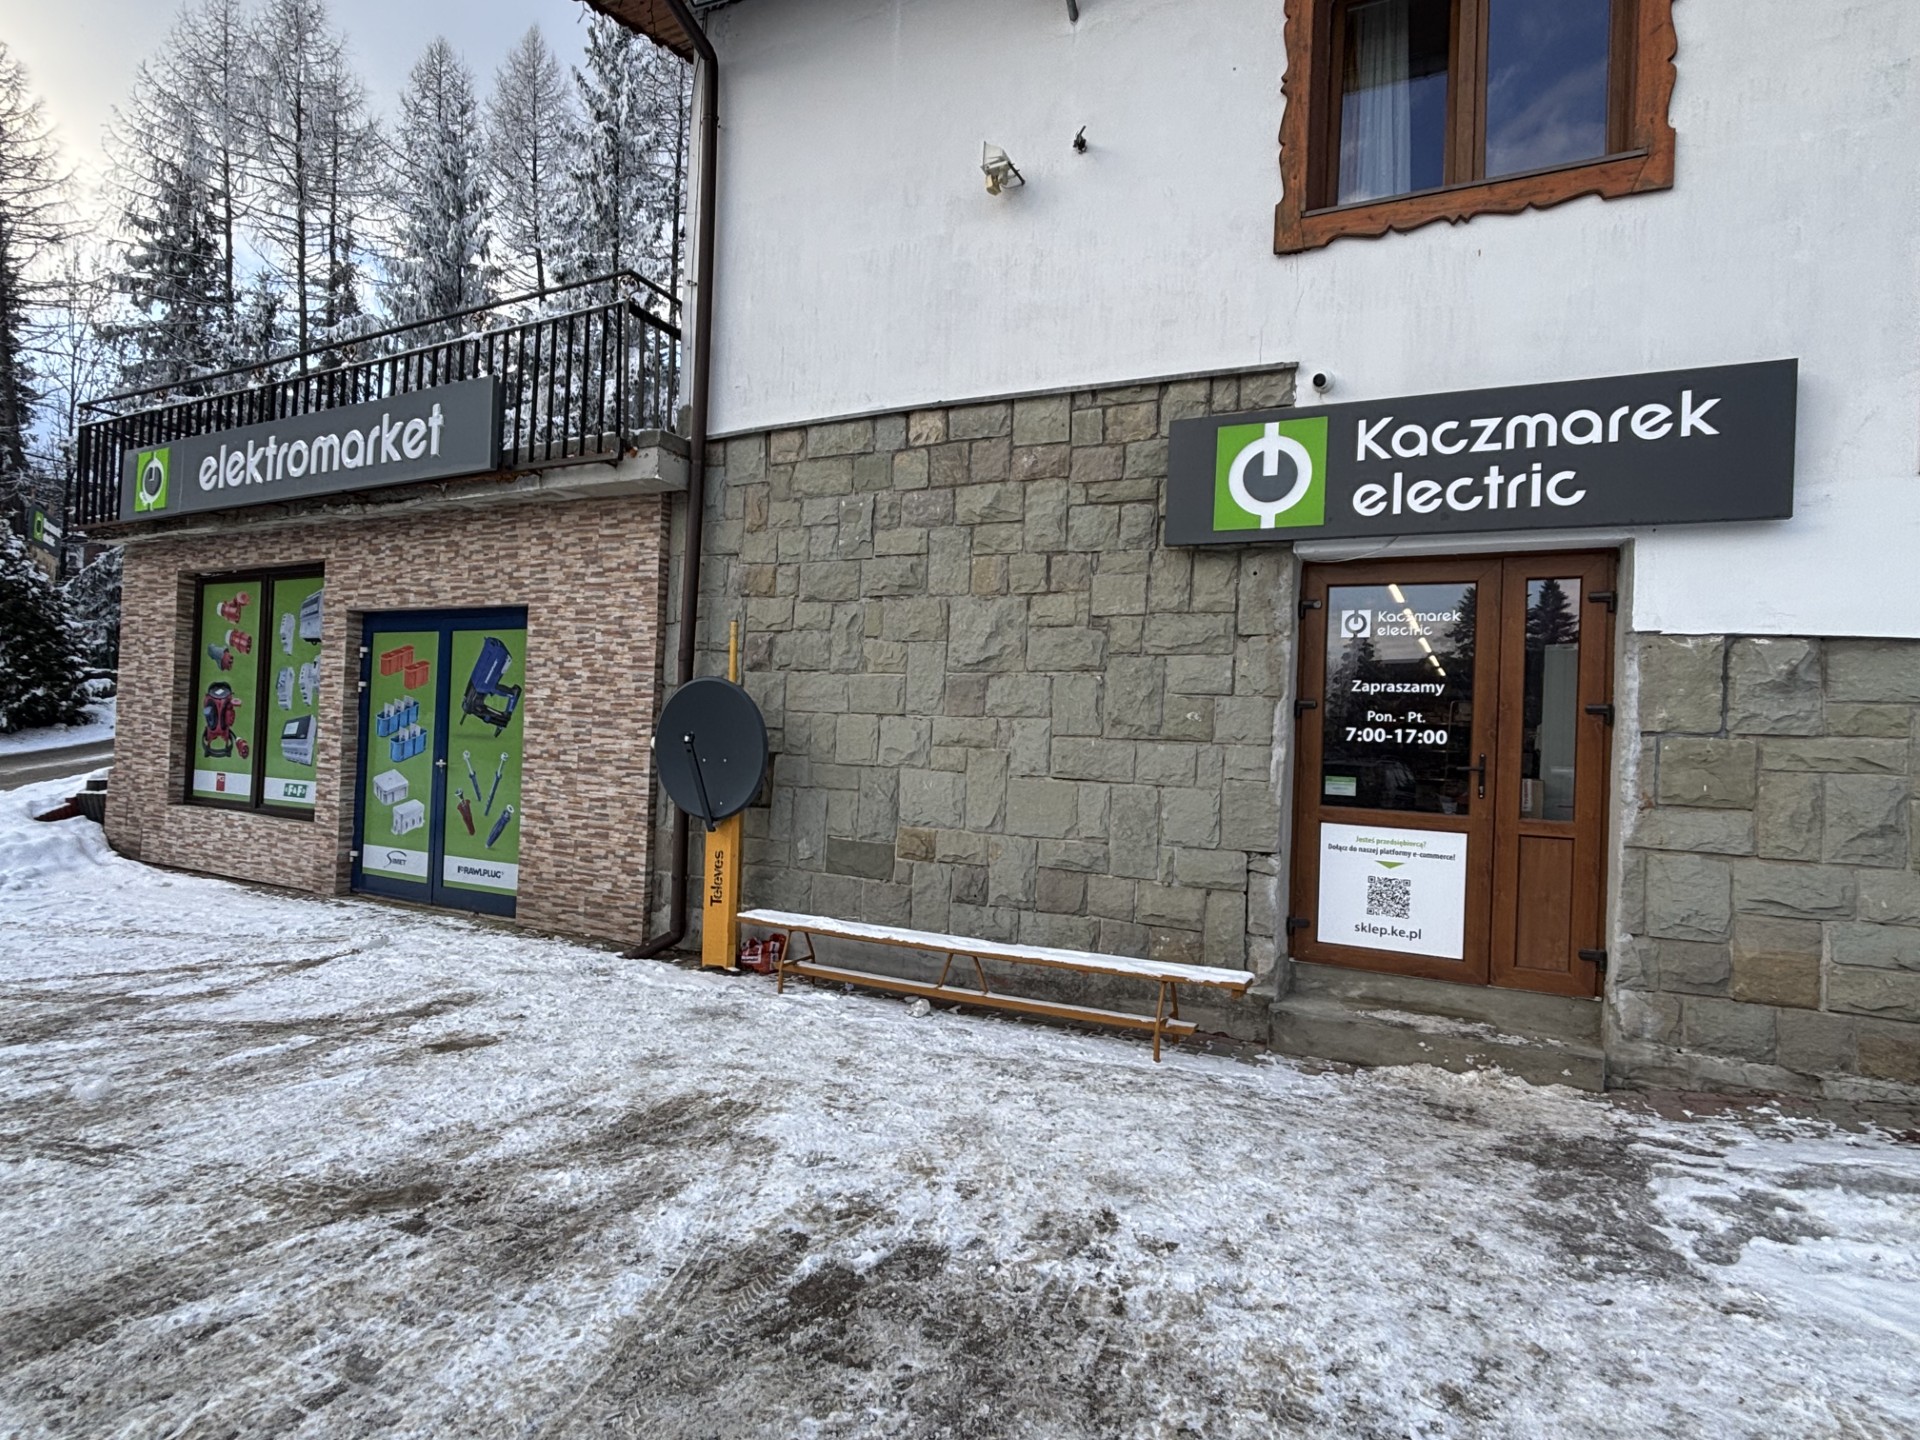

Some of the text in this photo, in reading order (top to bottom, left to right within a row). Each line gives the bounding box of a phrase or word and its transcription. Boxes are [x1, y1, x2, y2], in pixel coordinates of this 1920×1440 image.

[1356, 389, 1722, 462] Kaczmarek
[198, 403, 444, 492] elektromarket
[1352, 462, 1587, 517] electric
[1351, 680, 1445, 696] Zapraszamy
[1366, 710, 1397, 723] Pon.
[1407, 711, 1426, 723] Pt.
[1345, 727, 1448, 745] 7:00-17:00
[1328, 844, 1348, 852] Dołącz
[1358, 847, 1379, 855] naszej
[1380, 848, 1411, 858] platformy
[710, 850, 724, 907] Televes
[1354, 922, 1422, 941] sklep.ke.pl
